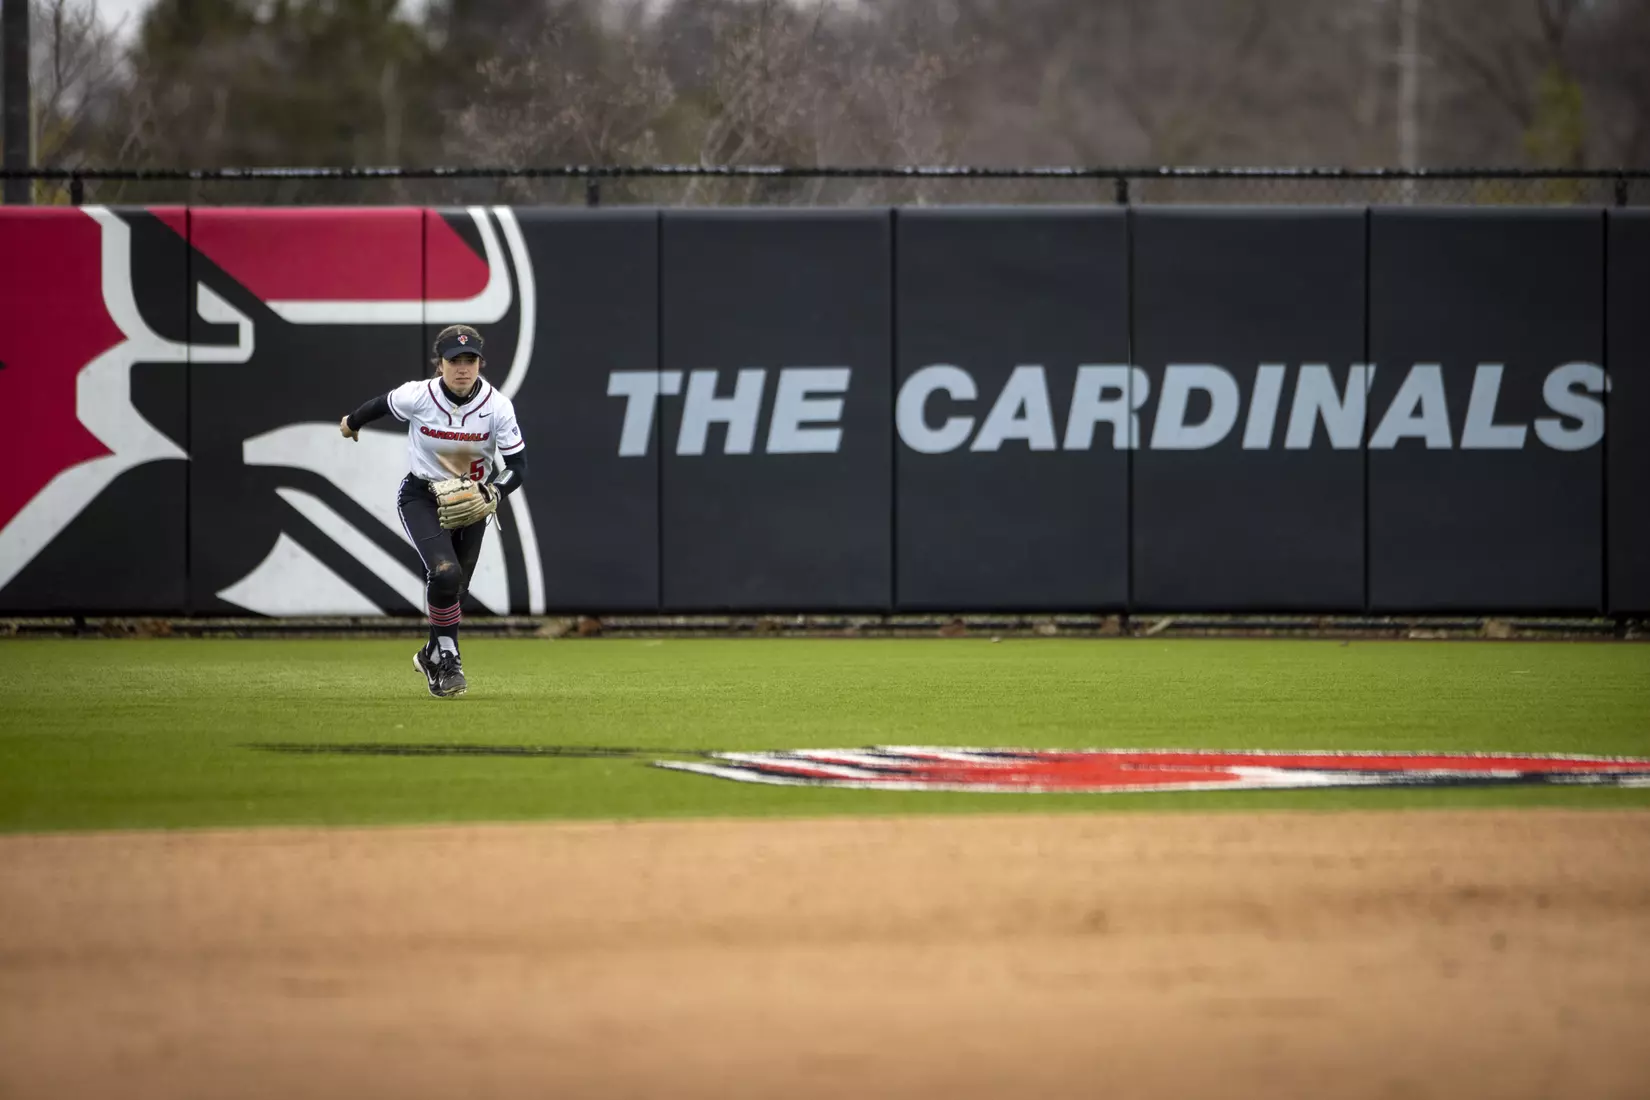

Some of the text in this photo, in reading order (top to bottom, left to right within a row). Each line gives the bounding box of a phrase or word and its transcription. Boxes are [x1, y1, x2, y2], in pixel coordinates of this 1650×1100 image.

[607, 361, 1611, 456] THE CARDINALS
[420, 425, 490, 441] CARDINALS
[469, 457, 485, 482] 5
